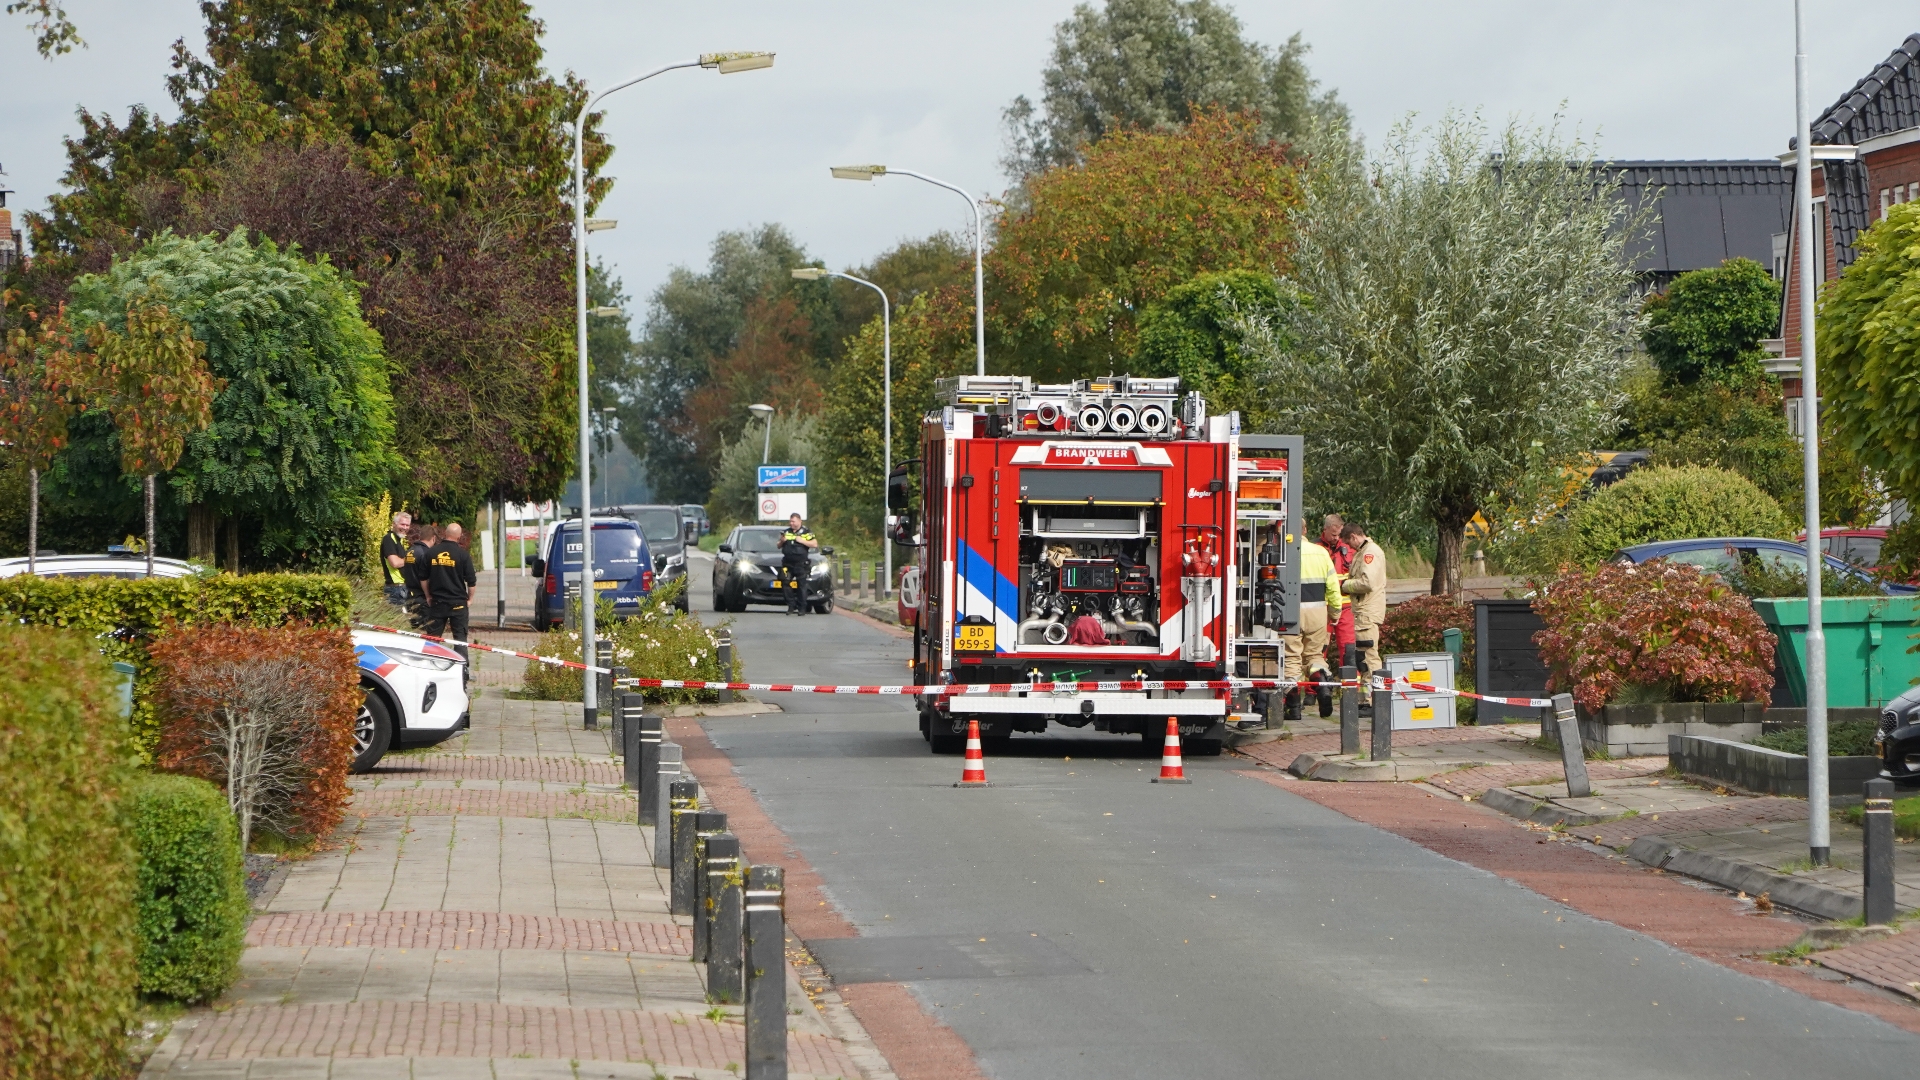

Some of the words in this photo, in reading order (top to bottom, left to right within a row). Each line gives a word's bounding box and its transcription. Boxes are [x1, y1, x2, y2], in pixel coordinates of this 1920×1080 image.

[1055, 449, 1128, 458] BRANDWEER
[970, 628, 984, 636] BD
[959, 640, 990, 648] 959-S
